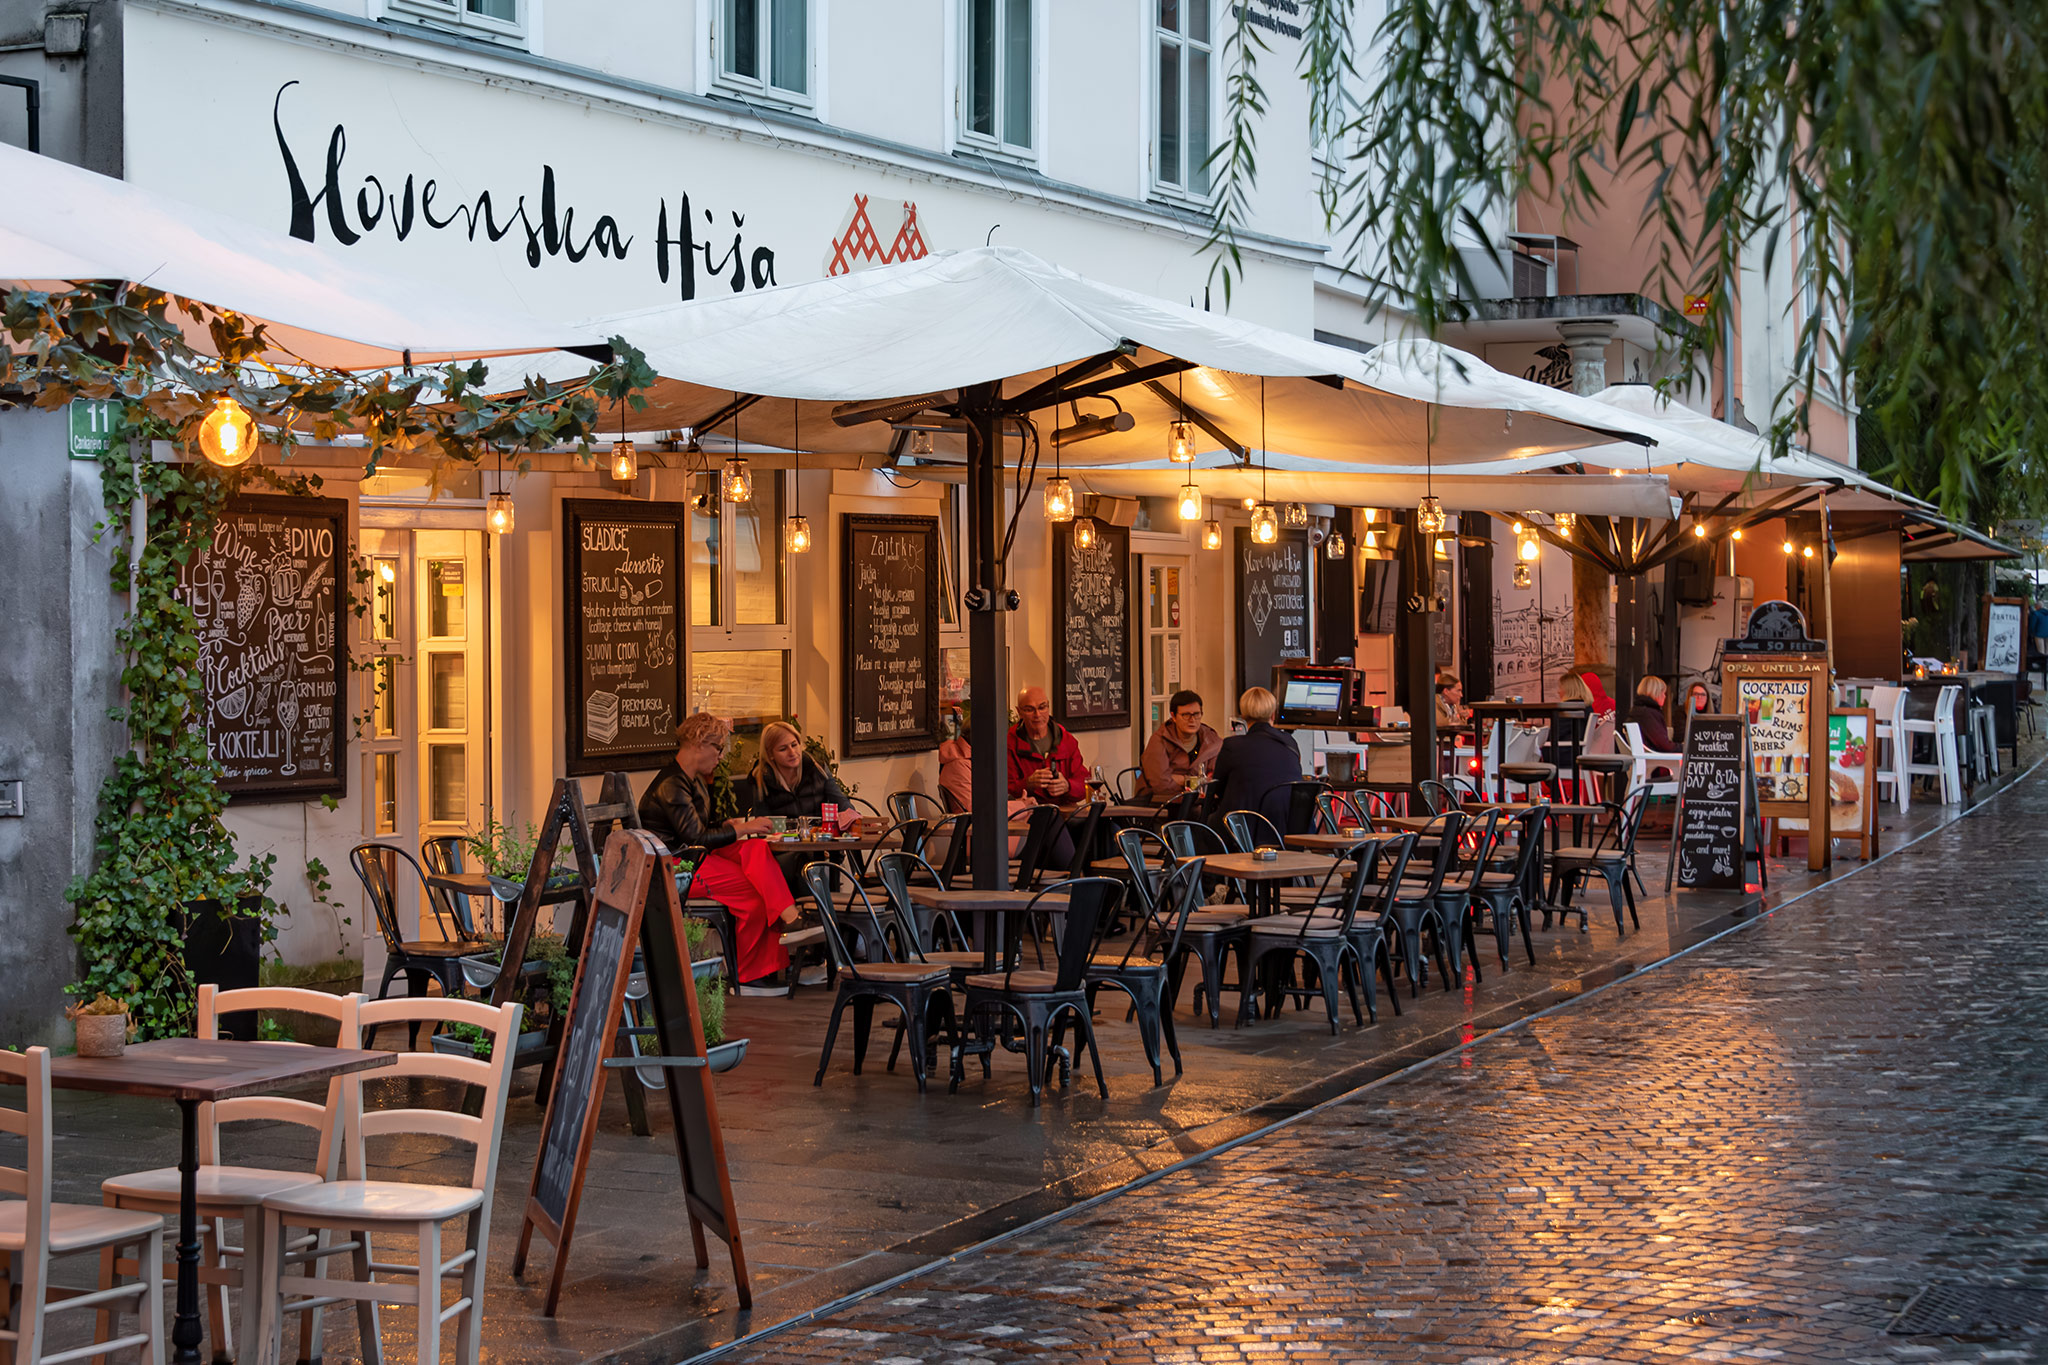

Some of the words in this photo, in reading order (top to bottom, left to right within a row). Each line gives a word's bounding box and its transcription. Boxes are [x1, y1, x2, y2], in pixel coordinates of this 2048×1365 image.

[273, 80, 634, 268] Slovenska
[656, 190, 777, 301] Hiša
[87, 403, 109, 433] 11
[213, 518, 263, 571] Wine
[291, 527, 334, 558] PIVO
[582, 527, 629, 552] SLADICE
[870, 535, 913, 565] Zajtrki
[615, 553, 665, 575] desserts
[582, 571, 619, 593] ŠTRUKLJI
[264, 607, 311, 641] Beer
[613, 618, 631, 632] cheese
[1790, 641, 1815, 651] FEET
[214, 635, 285, 694] Cocktails
[1726, 664, 1755, 673] OPEN
[1761, 664, 1794, 673] UNTIL
[1742, 682, 1807, 695] COCKTAILS
[621, 698, 663, 712] PREKMURSKA
[1775, 698, 1785, 715] 2
[1797, 697, 1806, 714] 1
[1771, 716, 1804, 733] RUMS
[1750, 726, 1794, 741] SNACKS
[219, 729, 279, 760] KOKTEJLI
[1697, 741, 1729, 752] breakfast
[1753, 741, 1786, 752] BEERS
[1687, 761, 1715, 775] EVERY
[1715, 768, 1739, 785] 8-12h
[1686, 775, 1705, 789] DAY
